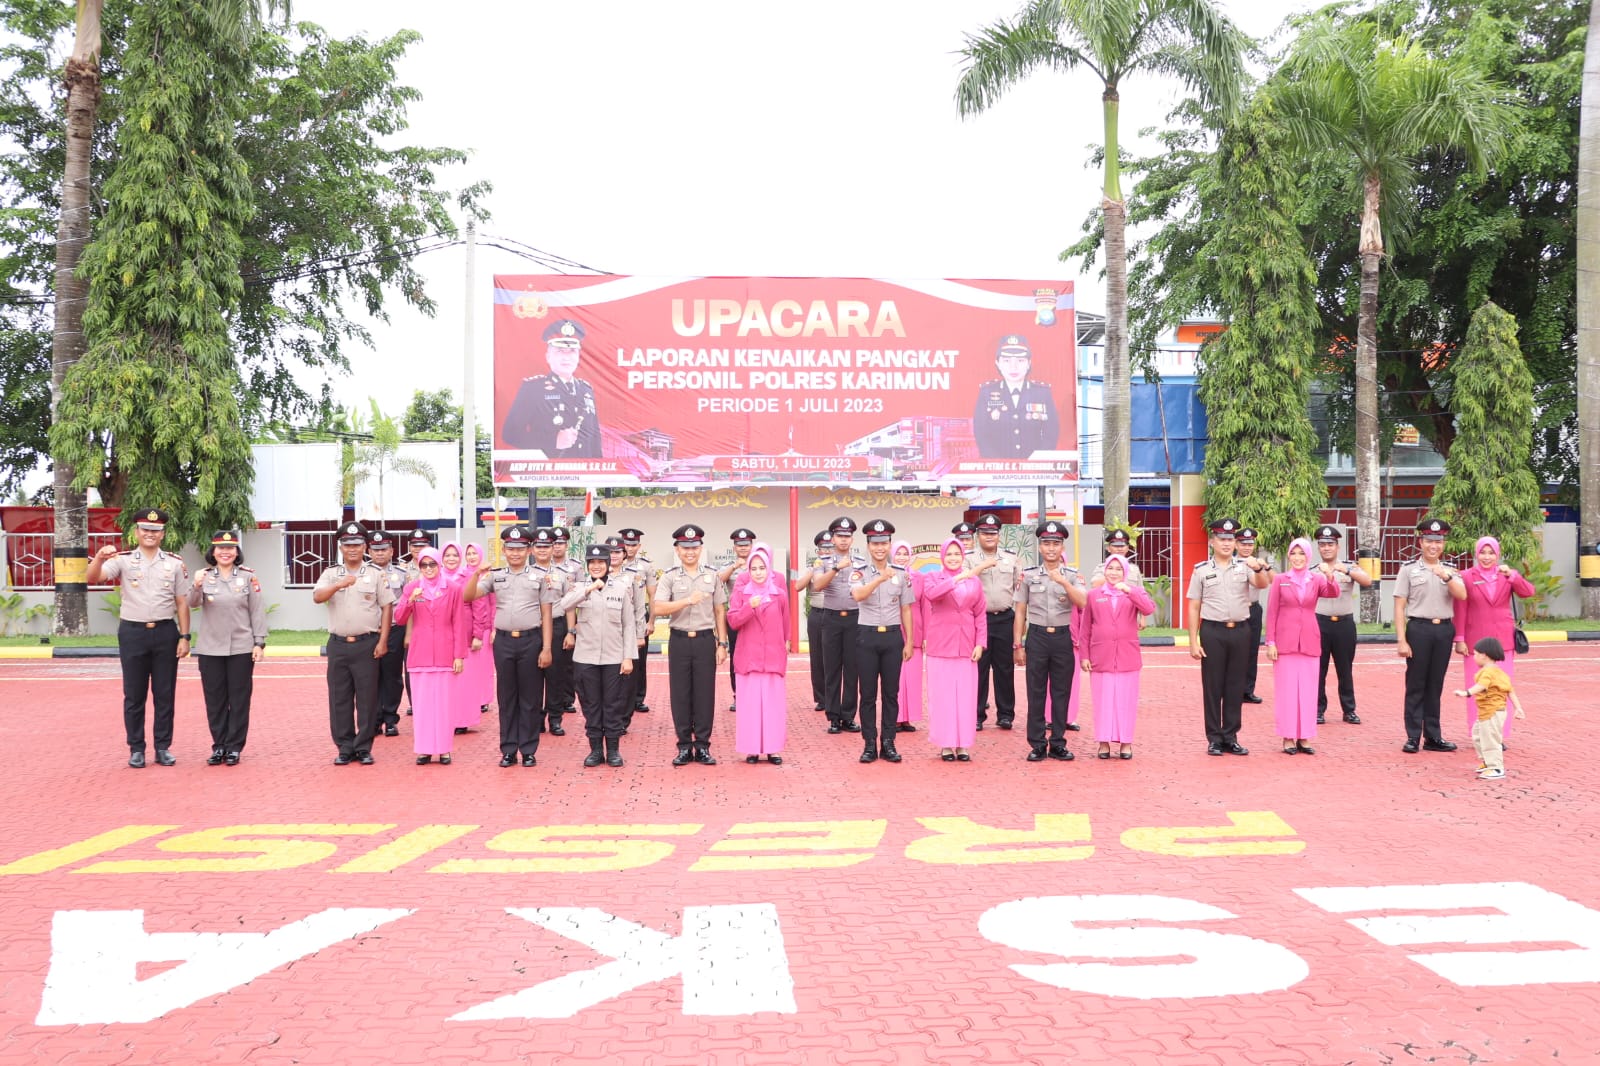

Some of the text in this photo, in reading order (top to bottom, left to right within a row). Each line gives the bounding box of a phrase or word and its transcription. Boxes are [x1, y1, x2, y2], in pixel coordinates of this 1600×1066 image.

[671, 299, 907, 337] UPACARA
[617, 348, 959, 369] LAPORAN KENAIKAN PANGKAT
[627, 371, 950, 390] PERSONIL POLRES KARIMUN
[697, 398, 884, 413] PERIODE 1 JULI 2023
[509, 462, 528, 472] AKBP
[731, 458, 852, 470] SABTU, 1 JULI 2023
